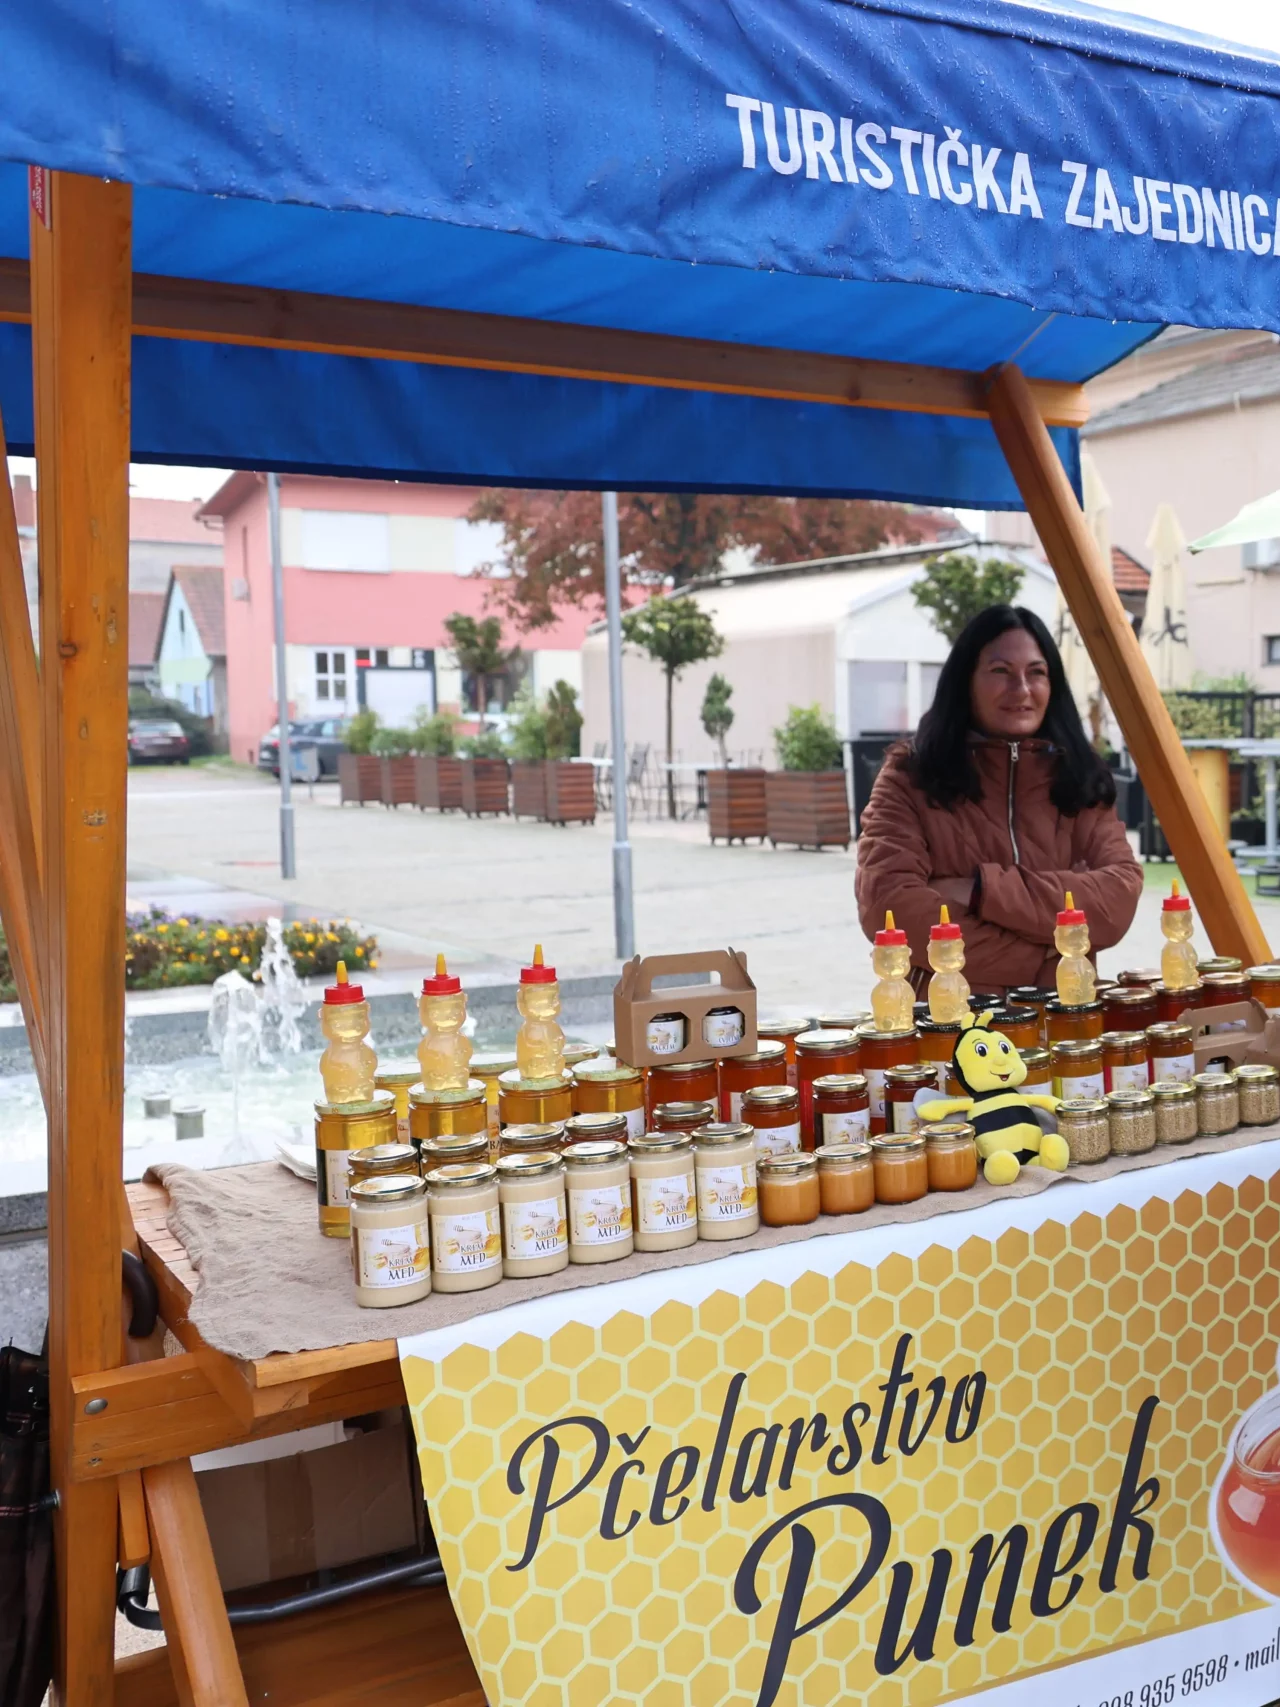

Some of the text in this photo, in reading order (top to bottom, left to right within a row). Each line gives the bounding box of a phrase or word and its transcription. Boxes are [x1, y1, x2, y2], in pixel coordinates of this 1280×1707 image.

[725, 93, 1043, 219] TURISTIČKA
[718, 1203, 742, 1215] MED
[665, 1213, 687, 1226] MED
[597, 1225, 621, 1238] MED
[534, 1237, 558, 1251] MED
[460, 1252, 486, 1266] MED
[388, 1266, 415, 1281] MED
[506, 1333, 986, 1571] Pčelarstvo
[735, 1395, 1160, 1707] Punek
[1140, 1674, 1176, 1707] 935
[1181, 1654, 1229, 1697] 9598
